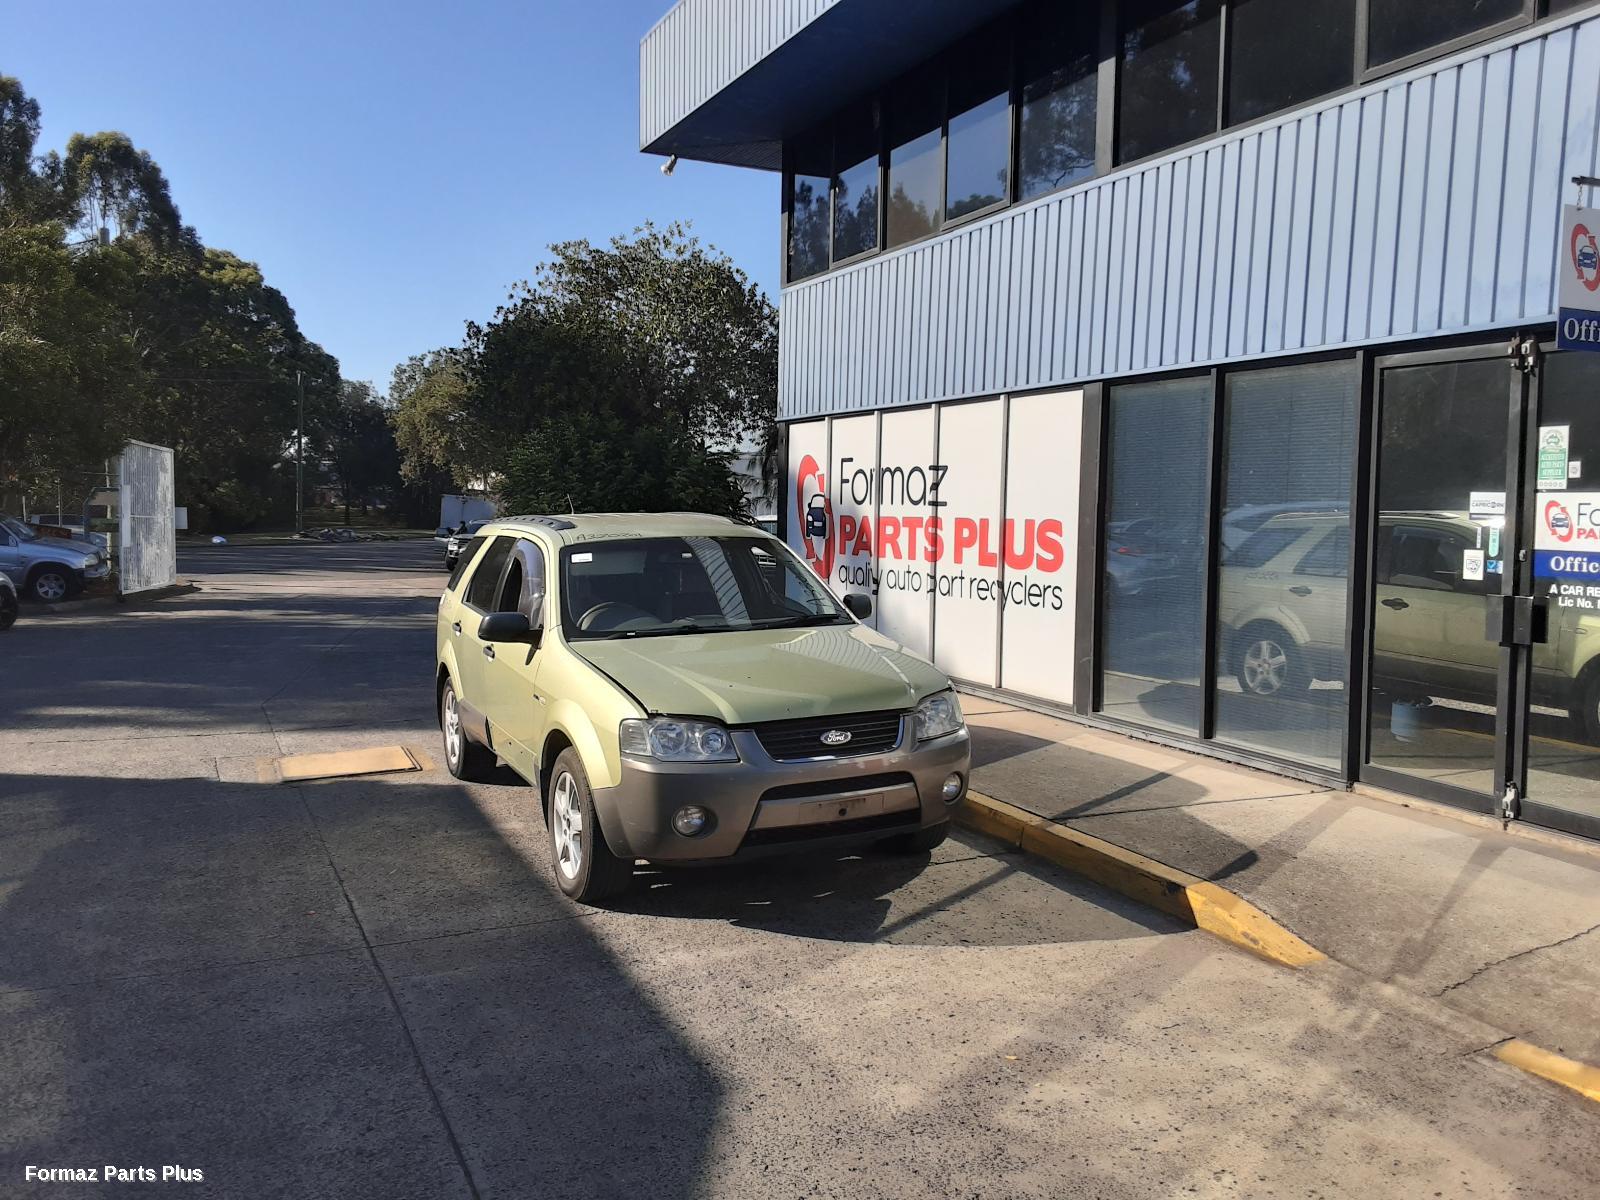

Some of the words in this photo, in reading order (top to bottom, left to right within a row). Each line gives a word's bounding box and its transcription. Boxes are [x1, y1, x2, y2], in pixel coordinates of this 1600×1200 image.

[840, 457, 949, 507] Formaz
[839, 515, 945, 563] PARTS
[954, 517, 1064, 573] PLUS
[1576, 527, 1600, 540] PA
[838, 561, 884, 595] qualiy
[886, 564, 922, 592] auto
[926, 569, 966, 600] part
[969, 575, 1064, 611] recyclers
[1549, 583, 1558, 594] A
[1560, 584, 1584, 596] CAR
[1558, 596, 1574, 607] Lic
[1576, 597, 1594, 609] No.
